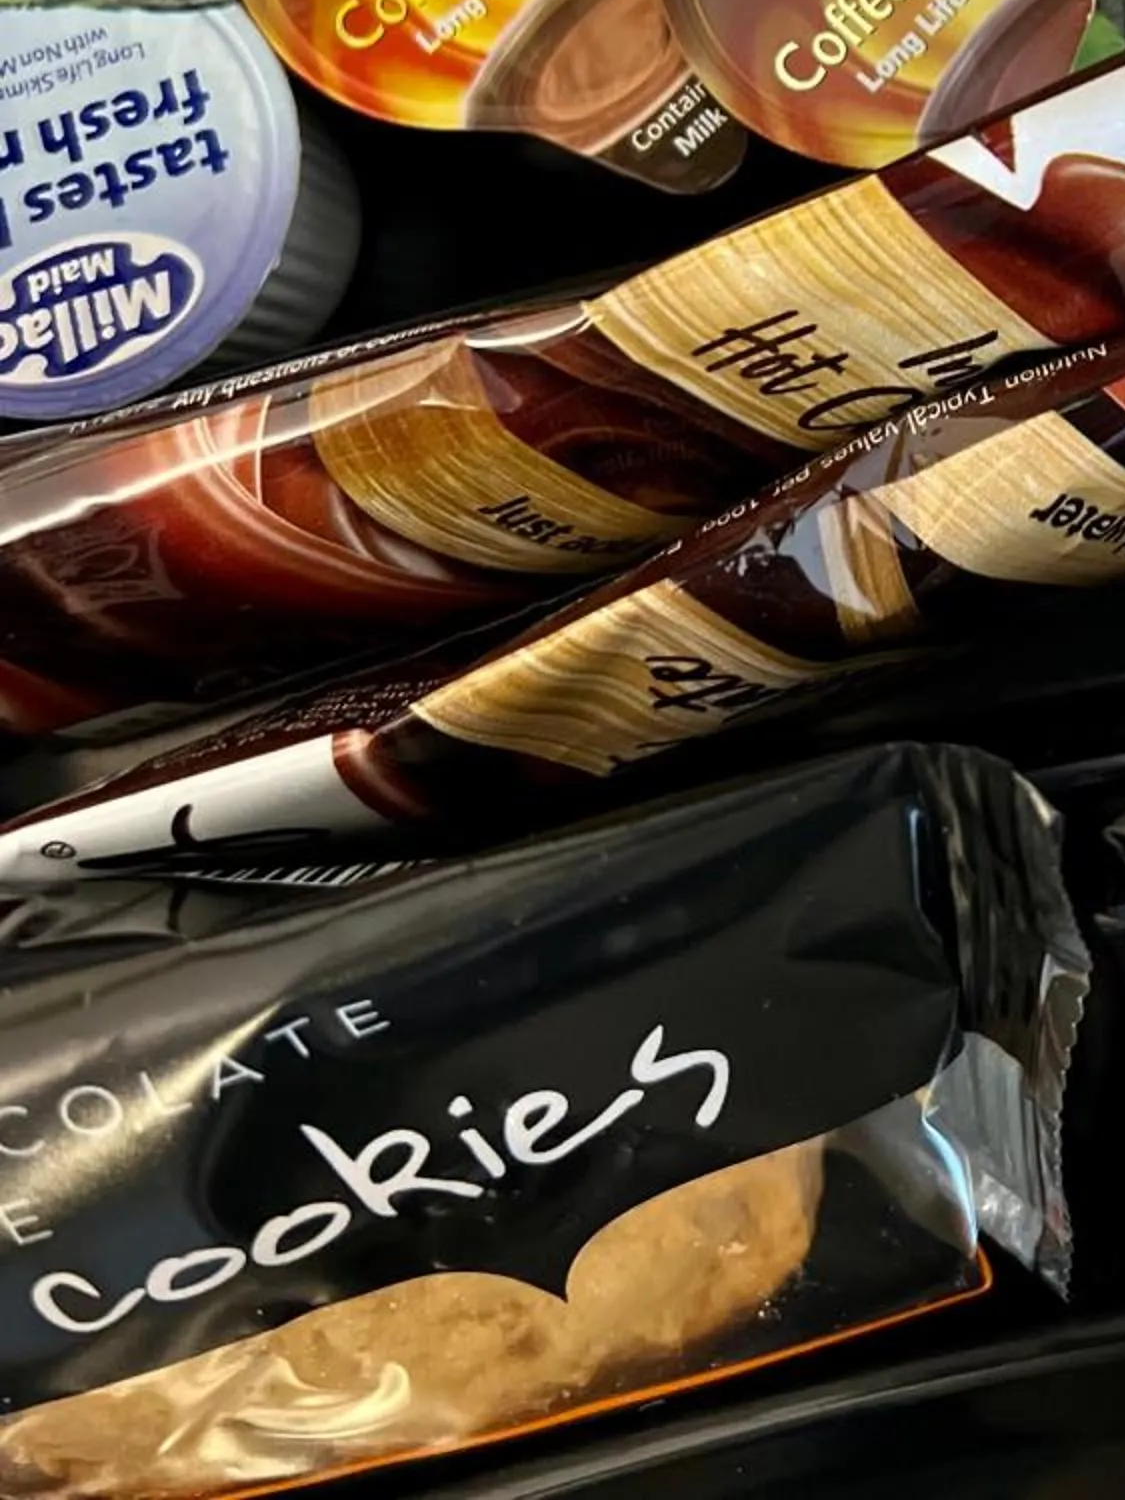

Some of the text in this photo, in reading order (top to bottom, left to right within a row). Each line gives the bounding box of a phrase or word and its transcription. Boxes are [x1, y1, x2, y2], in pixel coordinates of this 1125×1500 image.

[19, 43, 62, 71] Non
[63, 26, 109, 56] with
[93, 41, 146, 74] Long
[856, 31, 928, 95] Long
[55, 58, 95, 88] Life
[38, 68, 211, 164] fresh
[672, 107, 729, 158] Milk
[23, 128, 230, 224] tastes
[27, 247, 116, 303] Maid
[172, 383, 214, 410] Any
[219, 350, 328, 398] questions
[691, 309, 850, 397] Hot
[1003, 342, 1109, 391] Nutrition
[907, 383, 996, 438] Typical
[819, 417, 899, 470] values
[771, 466, 813, 501] per
[479, 495, 568, 547] Just
[0, 999, 391, 1159] COLATE
[31, 1024, 731, 1334] cookies
